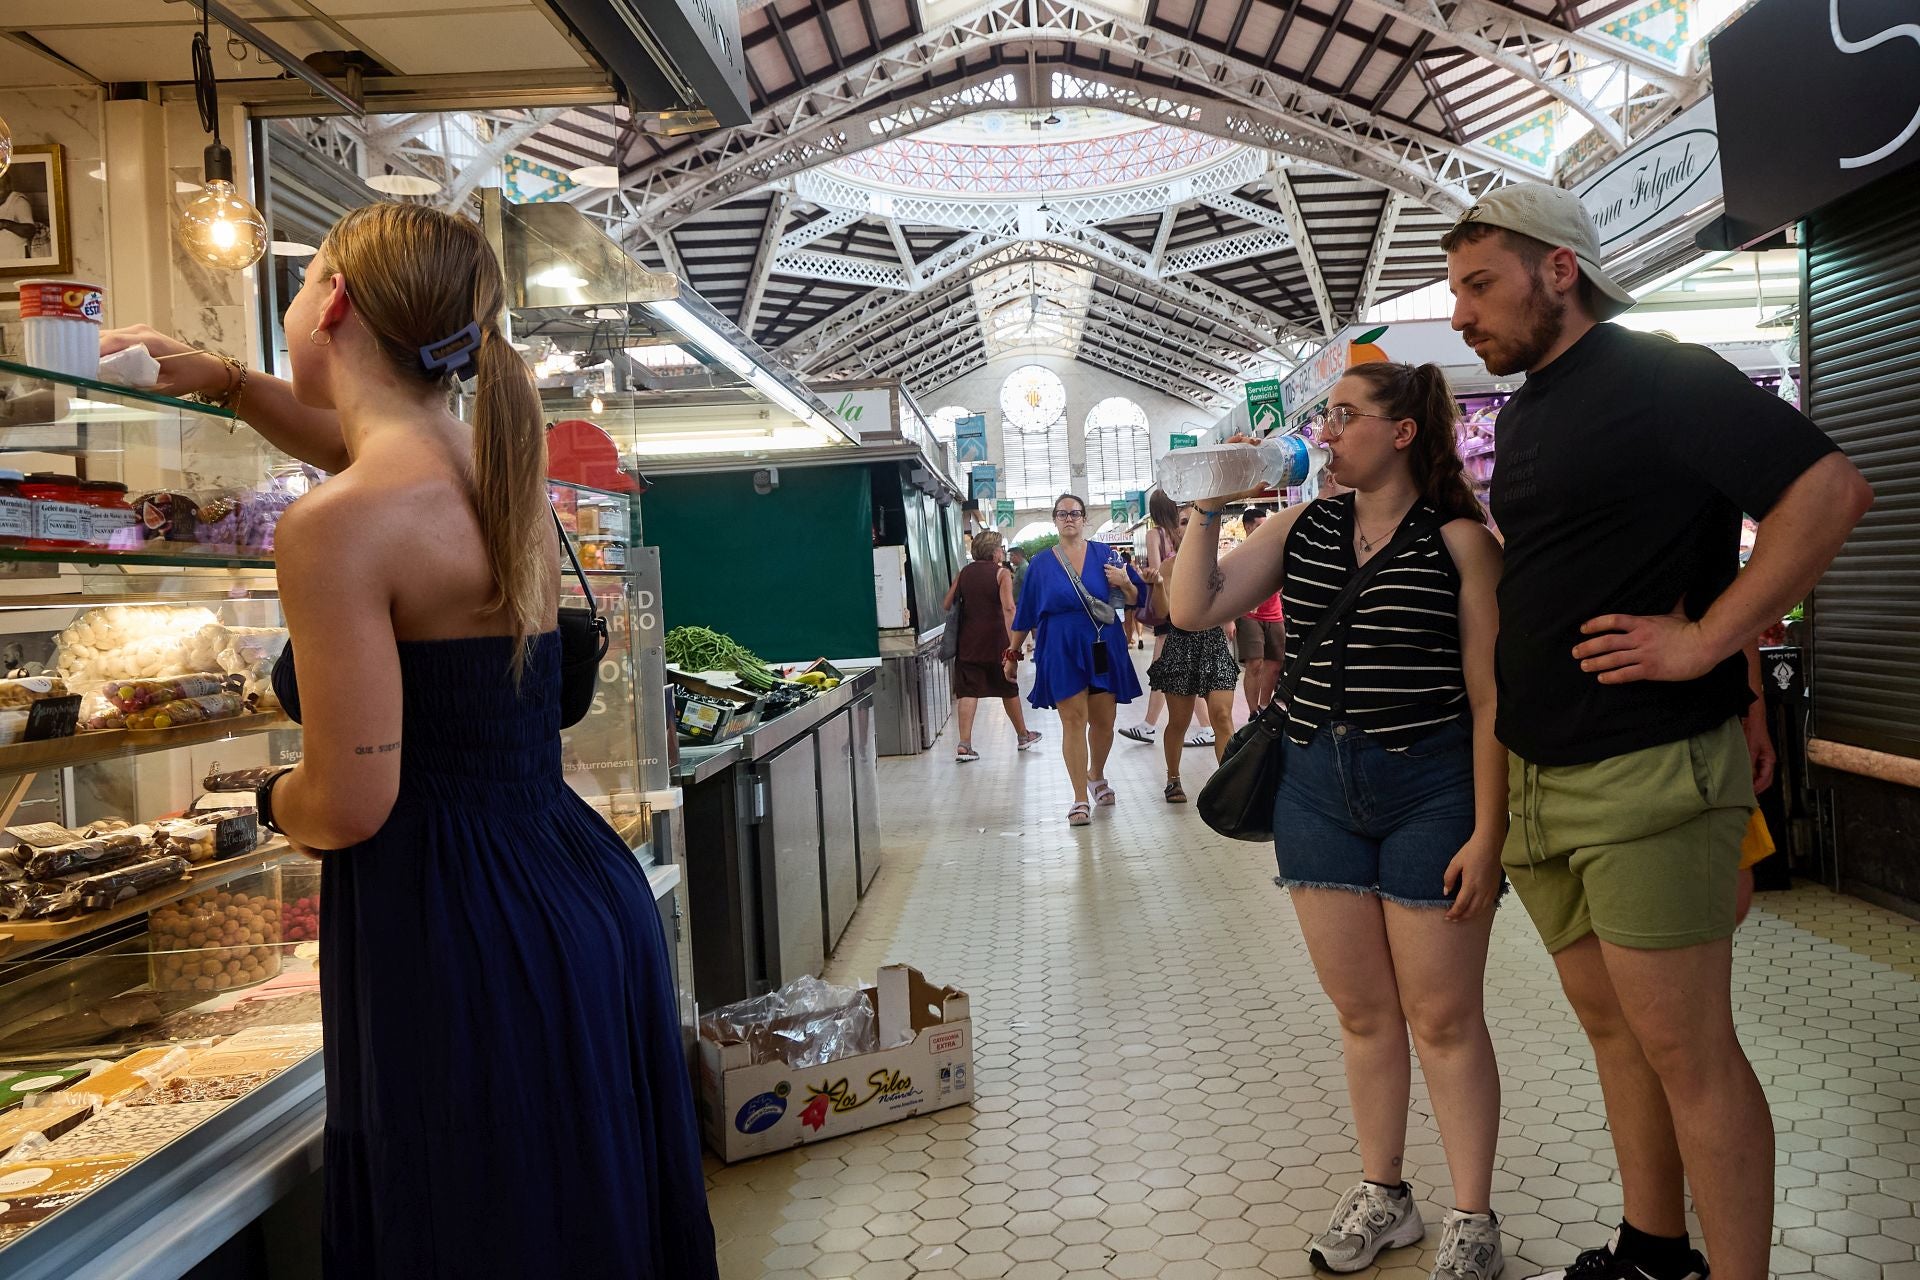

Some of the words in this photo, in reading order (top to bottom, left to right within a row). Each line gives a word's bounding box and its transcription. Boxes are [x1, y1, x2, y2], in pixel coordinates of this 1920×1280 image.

[1630, 142, 1695, 210] Folgado
[1247, 385, 1273, 394] Servicio
[1249, 391, 1279, 401] domicilio
[936, 1041, 956, 1050] EXTRA
[868, 1067, 911, 1096] Silos
